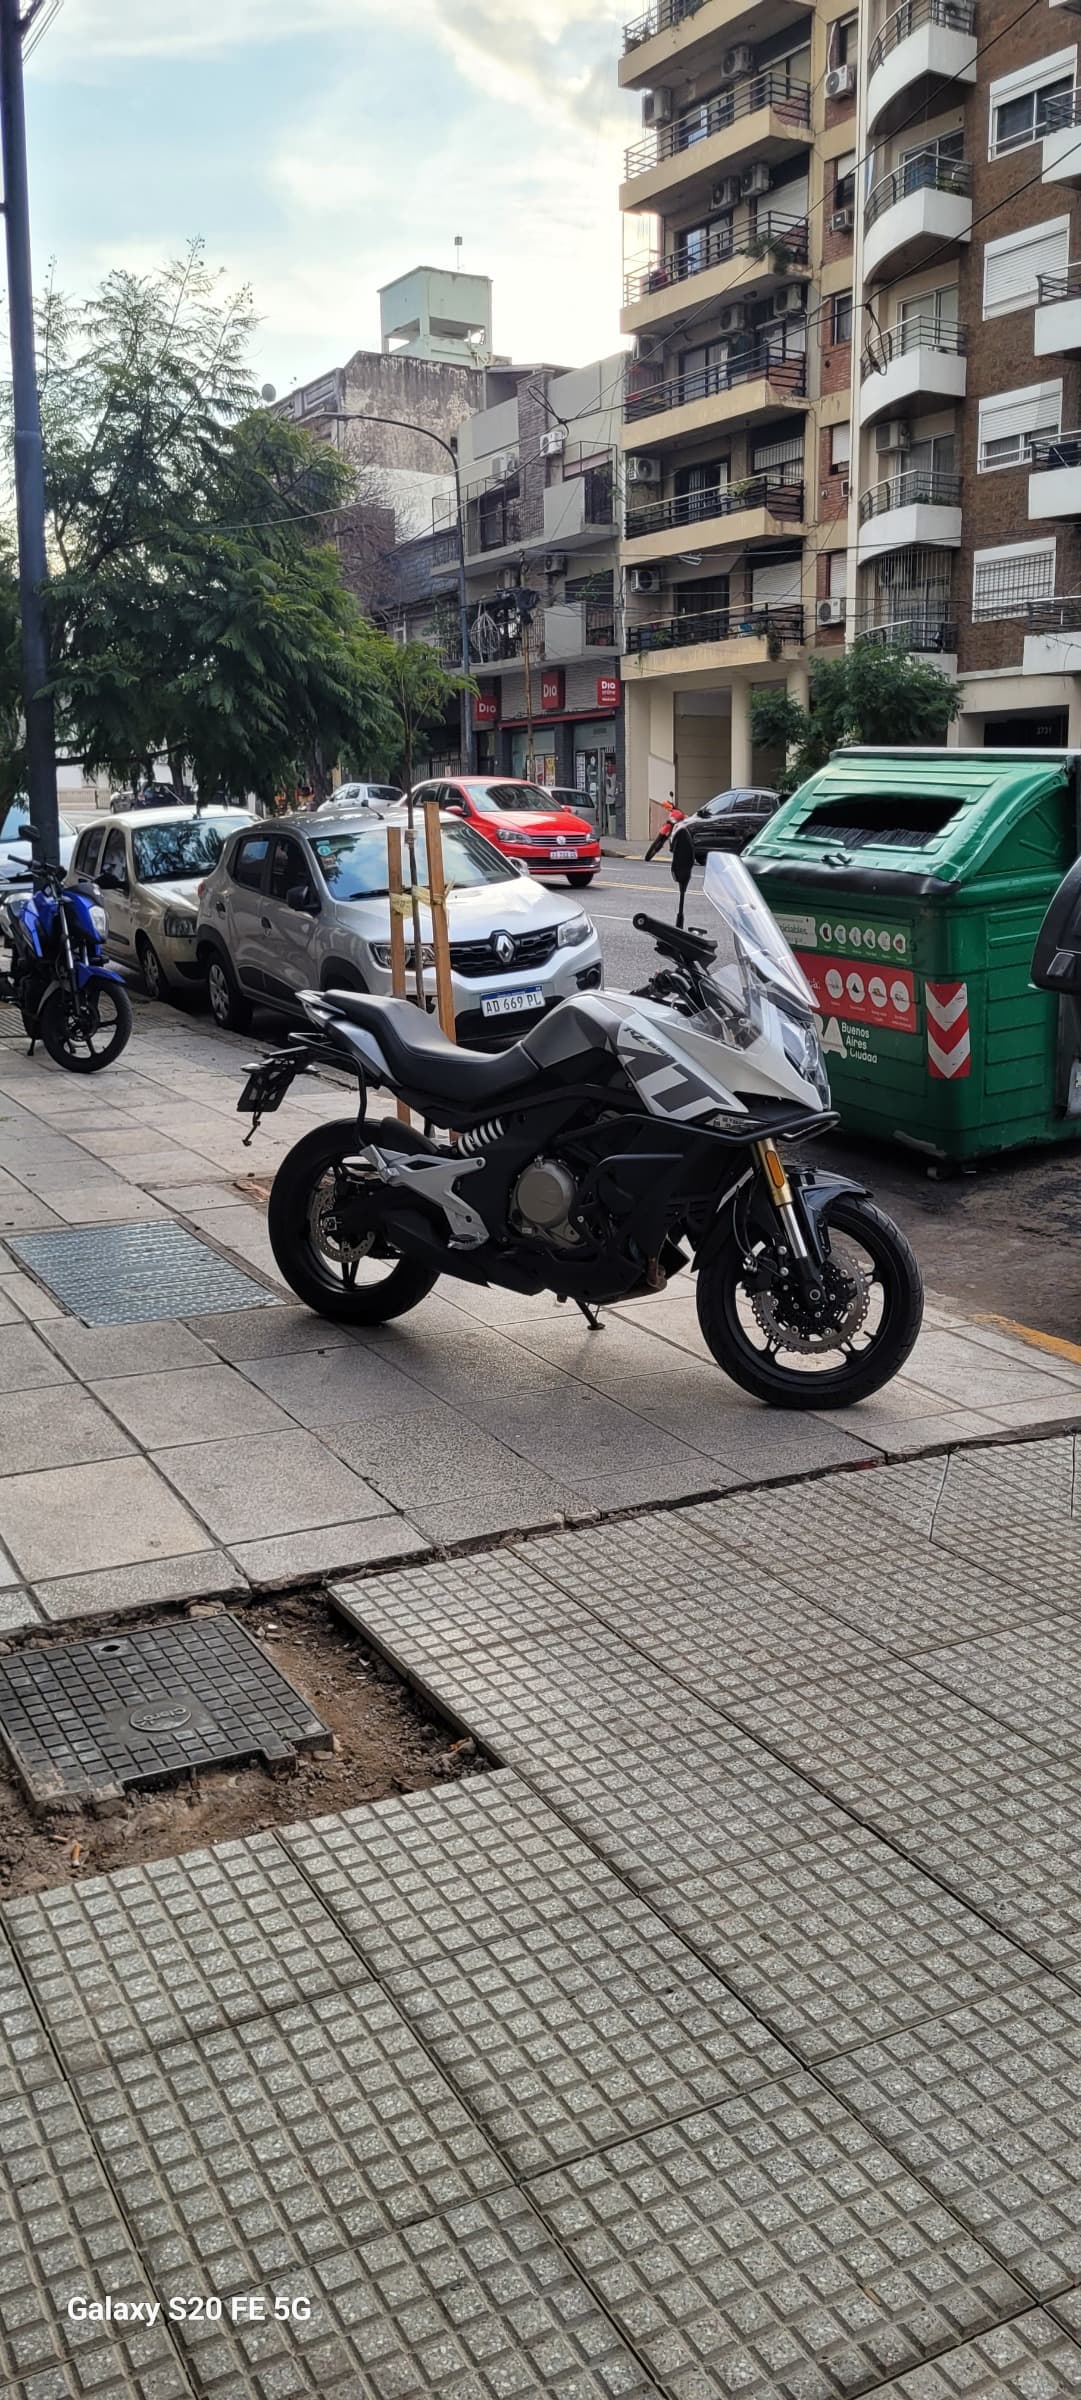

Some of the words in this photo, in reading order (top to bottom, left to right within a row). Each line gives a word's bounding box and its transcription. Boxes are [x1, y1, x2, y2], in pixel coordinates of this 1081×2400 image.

[486, 1000, 500, 1015] AD
[503, 996, 524, 1011] 669
[527, 993, 542, 1007] PL
[841, 1021, 870, 1039] Buenos
[846, 1035, 867, 1050] Aires
[849, 1047, 878, 1064] Ciudad
